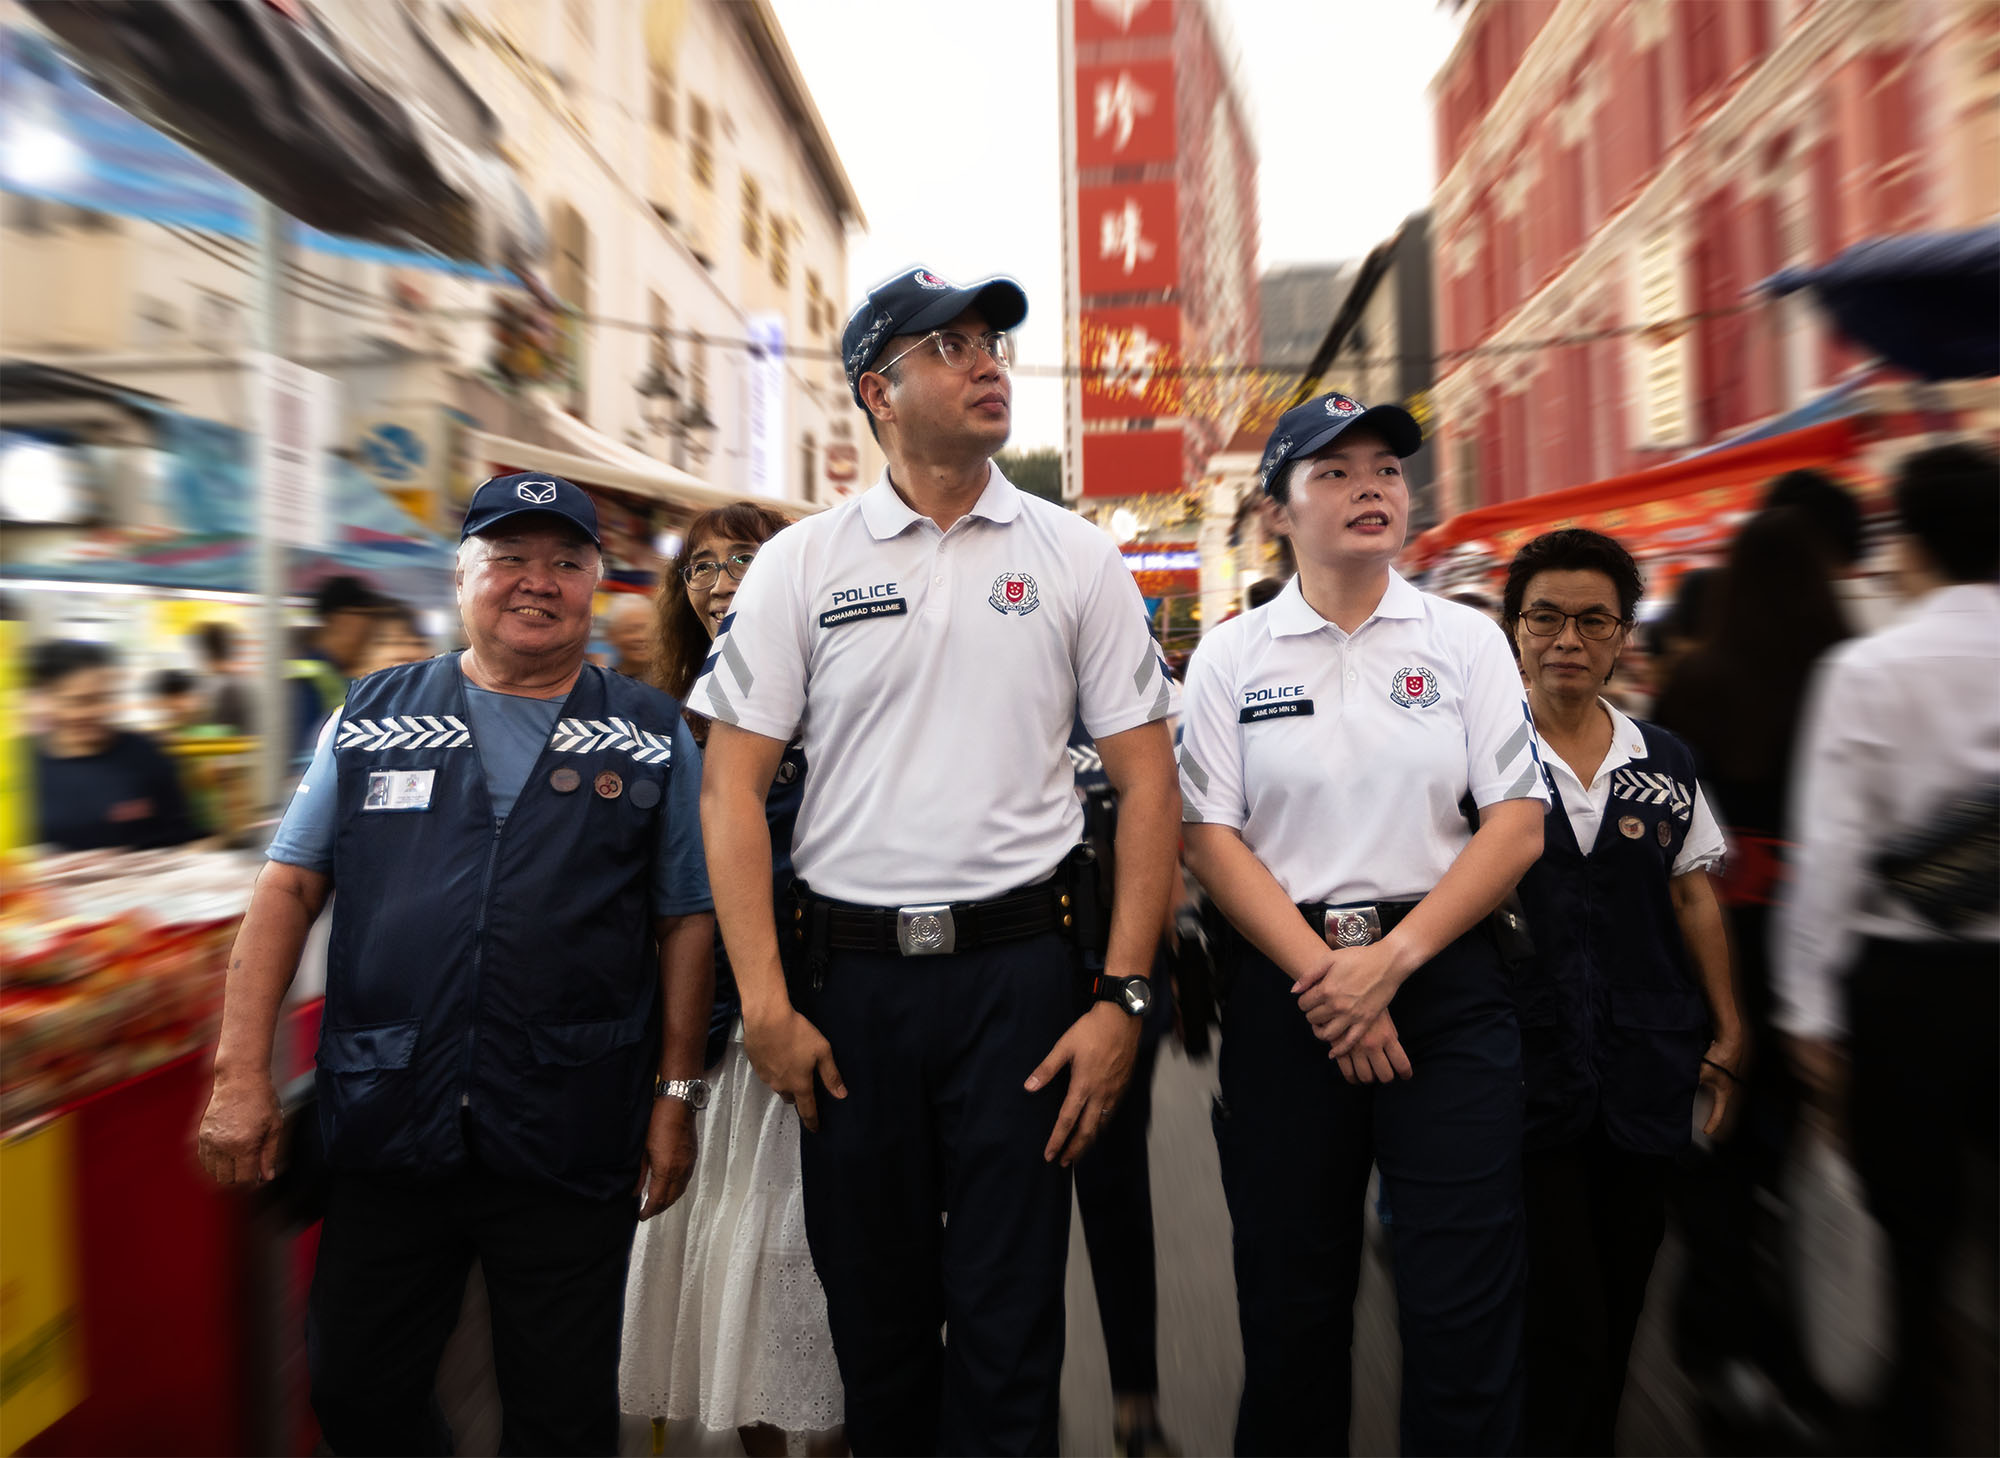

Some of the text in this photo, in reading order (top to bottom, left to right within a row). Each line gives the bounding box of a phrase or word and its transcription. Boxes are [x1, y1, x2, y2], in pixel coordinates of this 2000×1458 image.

[832, 583, 898, 606] POLICE
[824, 608, 868, 623] MOHAMMAD
[1245, 685, 1304, 704] POLICE
